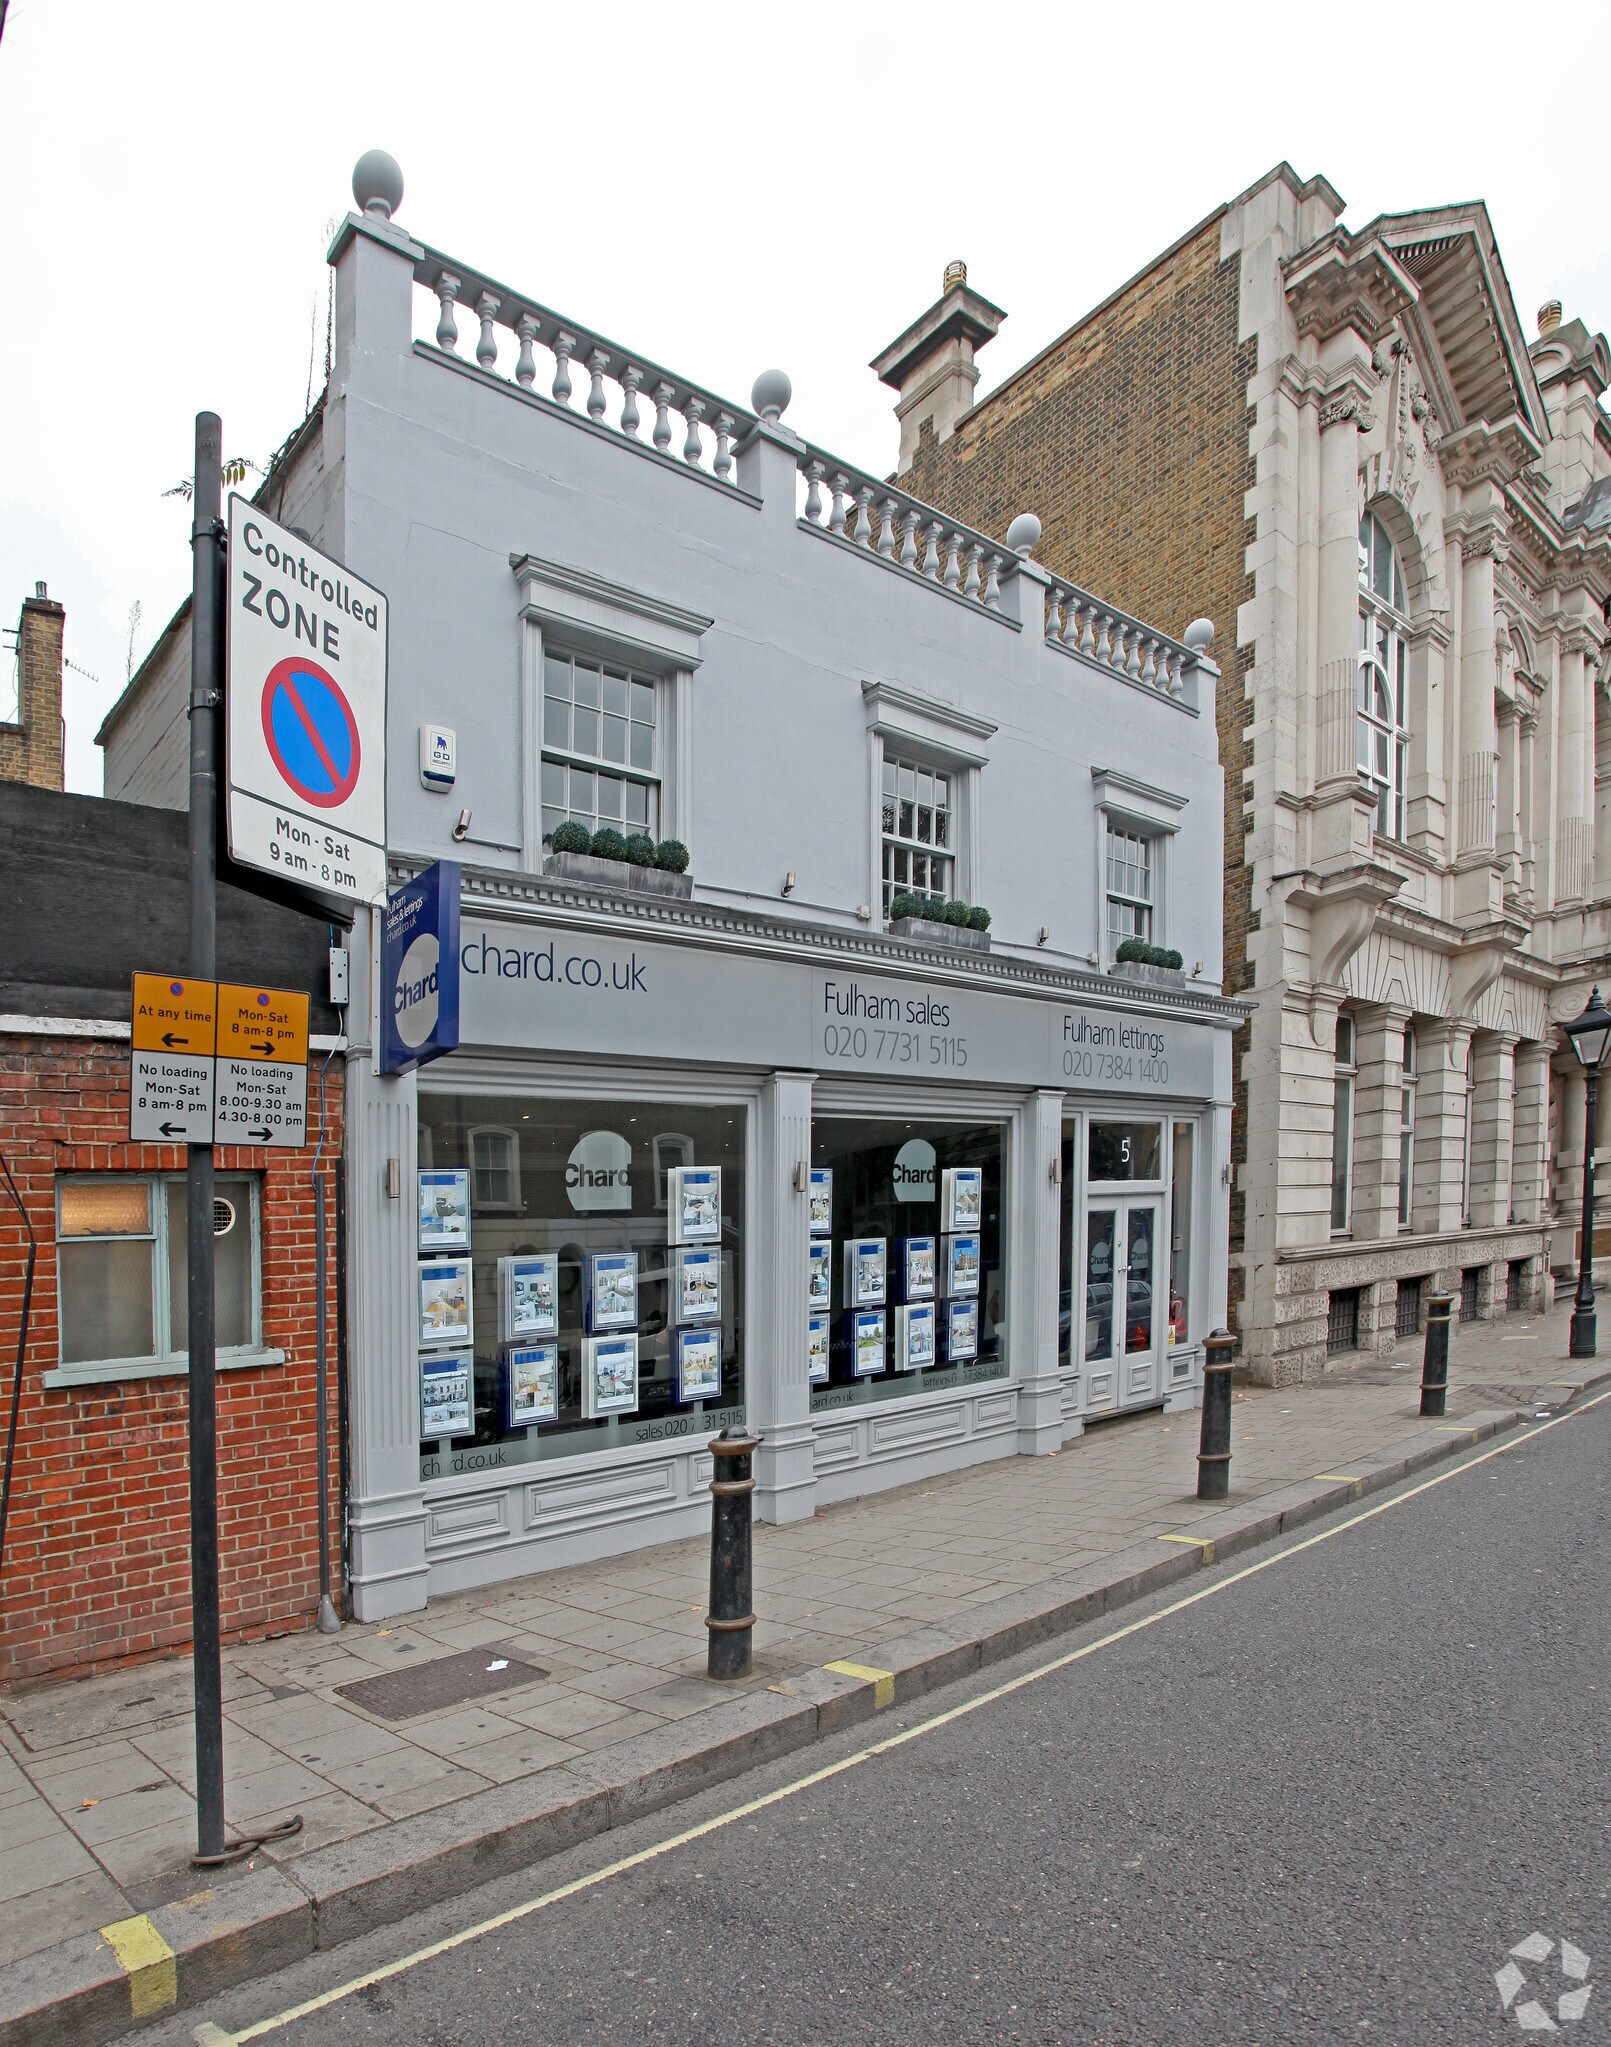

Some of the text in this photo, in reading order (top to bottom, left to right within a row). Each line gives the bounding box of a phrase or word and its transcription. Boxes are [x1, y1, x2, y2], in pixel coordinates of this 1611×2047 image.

[243, 521, 378, 632] Controlled
[242, 570, 340, 662] ZONE
[276, 816, 311, 847] Mon
[324, 836, 350, 862] Sat
[269, 841, 280, 861] 9
[284, 850, 308, 871] am
[321, 864, 330, 881] 8
[334, 869, 357, 888] pm
[461, 933, 648, 993] chard.co.uk
[394, 962, 439, 1015] Chard
[138, 1004, 211, 1022] At any time
[238, 1008, 289, 1024] Mon-Sat
[824, 982, 950, 1027] Fulham sales
[231, 1023, 294, 1040] 8 am-8 pm
[1063, 1015, 1165, 1058] Fulham lettings
[824, 1024, 968, 1067] 020 7731 5115
[139, 1063, 208, 1081] No loading
[230, 1064, 293, 1081] No loading
[1063, 1050, 1169, 1084] 020 7384 1400
[145, 1081, 201, 1096] Mon-Sat
[236, 1082, 287, 1095] Mon-Sat
[138, 1097, 207, 1112] 8 am-8 pm
[219, 1095, 302, 1111] 8.00-9.30 am
[218, 1111, 302, 1127] 4.30-8.00 pm
[1121, 1139, 1130, 1163] 5
[565, 1163, 632, 1188] Chard
[891, 1164, 936, 1183] Chard
[635, 1410, 743, 1442] sales 020 731 5115
[422, 1447, 507, 1477] chd.co.uk
